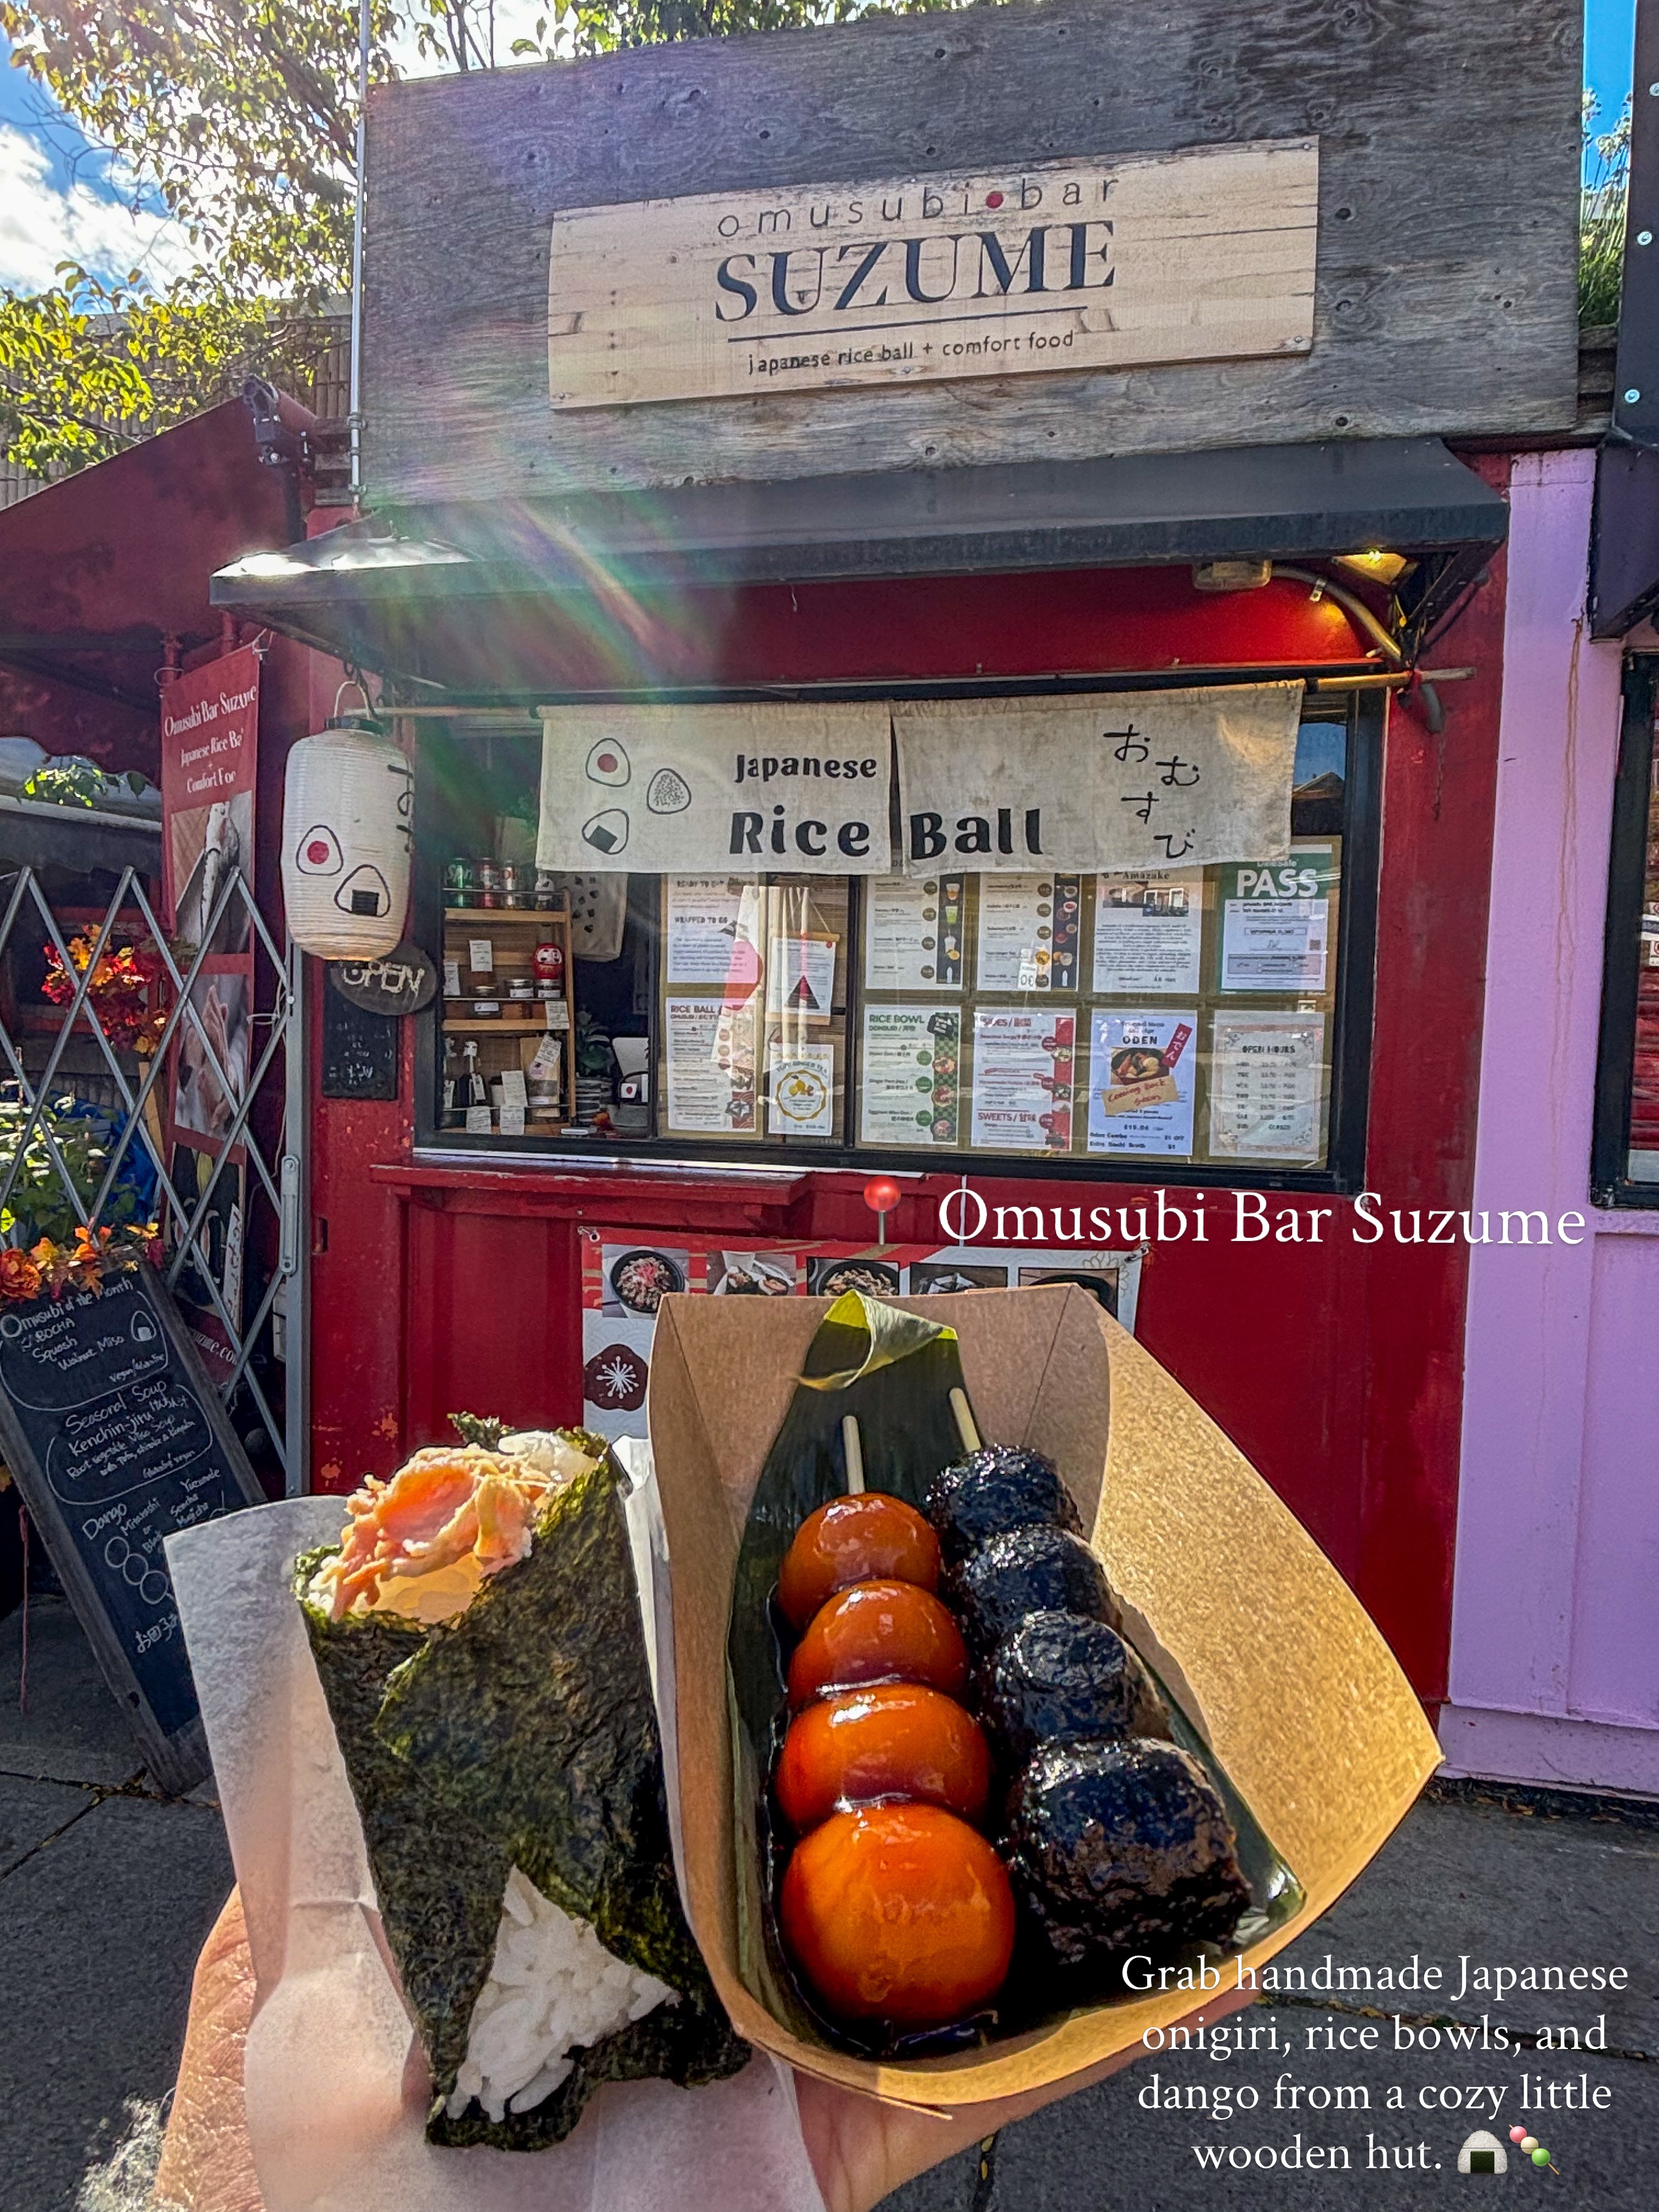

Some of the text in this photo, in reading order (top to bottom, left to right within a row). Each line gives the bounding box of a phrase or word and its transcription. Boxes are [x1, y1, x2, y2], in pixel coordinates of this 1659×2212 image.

[718, 178, 1119, 236] omusubi bar
[715, 221, 1115, 322] SUZUME
[749, 330, 1073, 376] japanese rice ball + comfort food
[165, 686, 257, 737] Omusubi Bar Suzume
[211, 737, 228, 754] Rice
[187, 770, 217, 793] Comfort
[735, 754, 877, 783] Japanese
[1103, 724, 1200, 859] おむすび
[729, 805, 1043, 860] Rice Ball
[1123, 870, 1170, 879] Amazake
[1237, 868, 1318, 898] PASS
[671, 1005, 691, 1013] RICE
[694, 1005, 715, 1013] BALL
[870, 1014, 924, 1024] RICE BOWL
[1123, 1036, 1158, 1045] ODEN
[1242, 1045, 1296, 1053] OPEN HOURS
[1108, 1087, 1141, 1102] Coming
[978, 1113, 1012, 1121] SWEETS
[1, 1302, 64, 1338] Omusubi
[32, 1336, 78, 1363] Squash
[97, 1336, 125, 1352] Miso
[65, 1380, 167, 1435] Seasonal Soup
[68, 1412, 155, 1457] Kenchin-jiru
[82, 1503, 127, 1540] Dango
